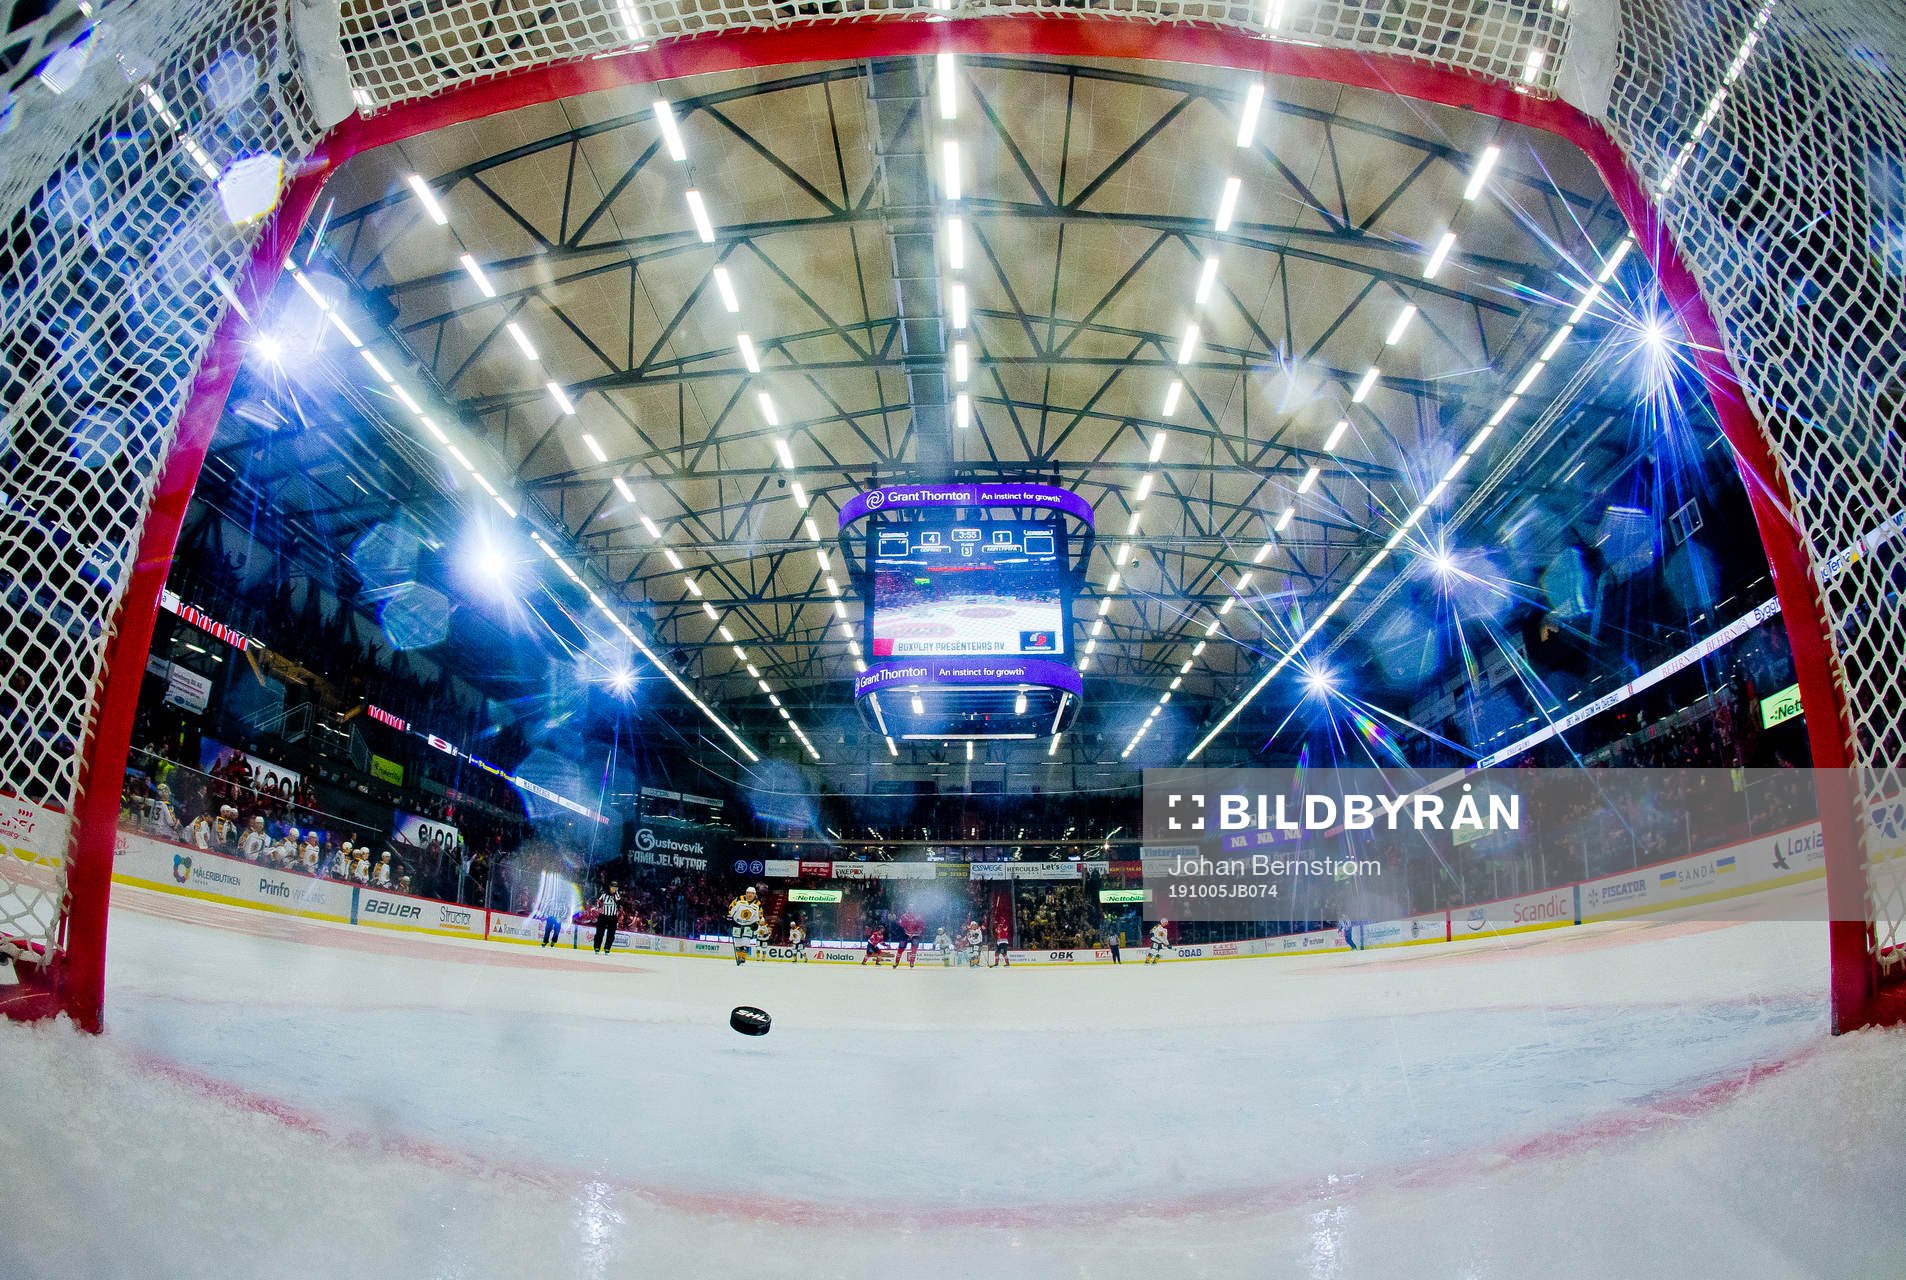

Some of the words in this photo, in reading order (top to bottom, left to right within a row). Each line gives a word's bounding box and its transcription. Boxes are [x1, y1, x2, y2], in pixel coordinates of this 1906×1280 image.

[888, 492, 919, 502] Grant
[920, 490, 970, 500] Thornton
[994, 492, 1022, 500] instinct
[1024, 492, 1034, 500] for
[1035, 494, 1060, 503] growth
[928, 534, 936, 542] 4
[998, 534, 1004, 542] 1
[898, 642, 934, 651] BOXPLAY
[860, 673, 880, 688] Grant
[880, 667, 928, 680] Thornton
[952, 668, 981, 676] instinct
[984, 668, 995, 676] for
[996, 668, 1024, 678] growth
[260, 879, 290, 898] Prinfo
[1602, 880, 1646, 898] PISCATOR
[1514, 896, 1568, 923] Scandic
[1050, 952, 1074, 960] OBK
